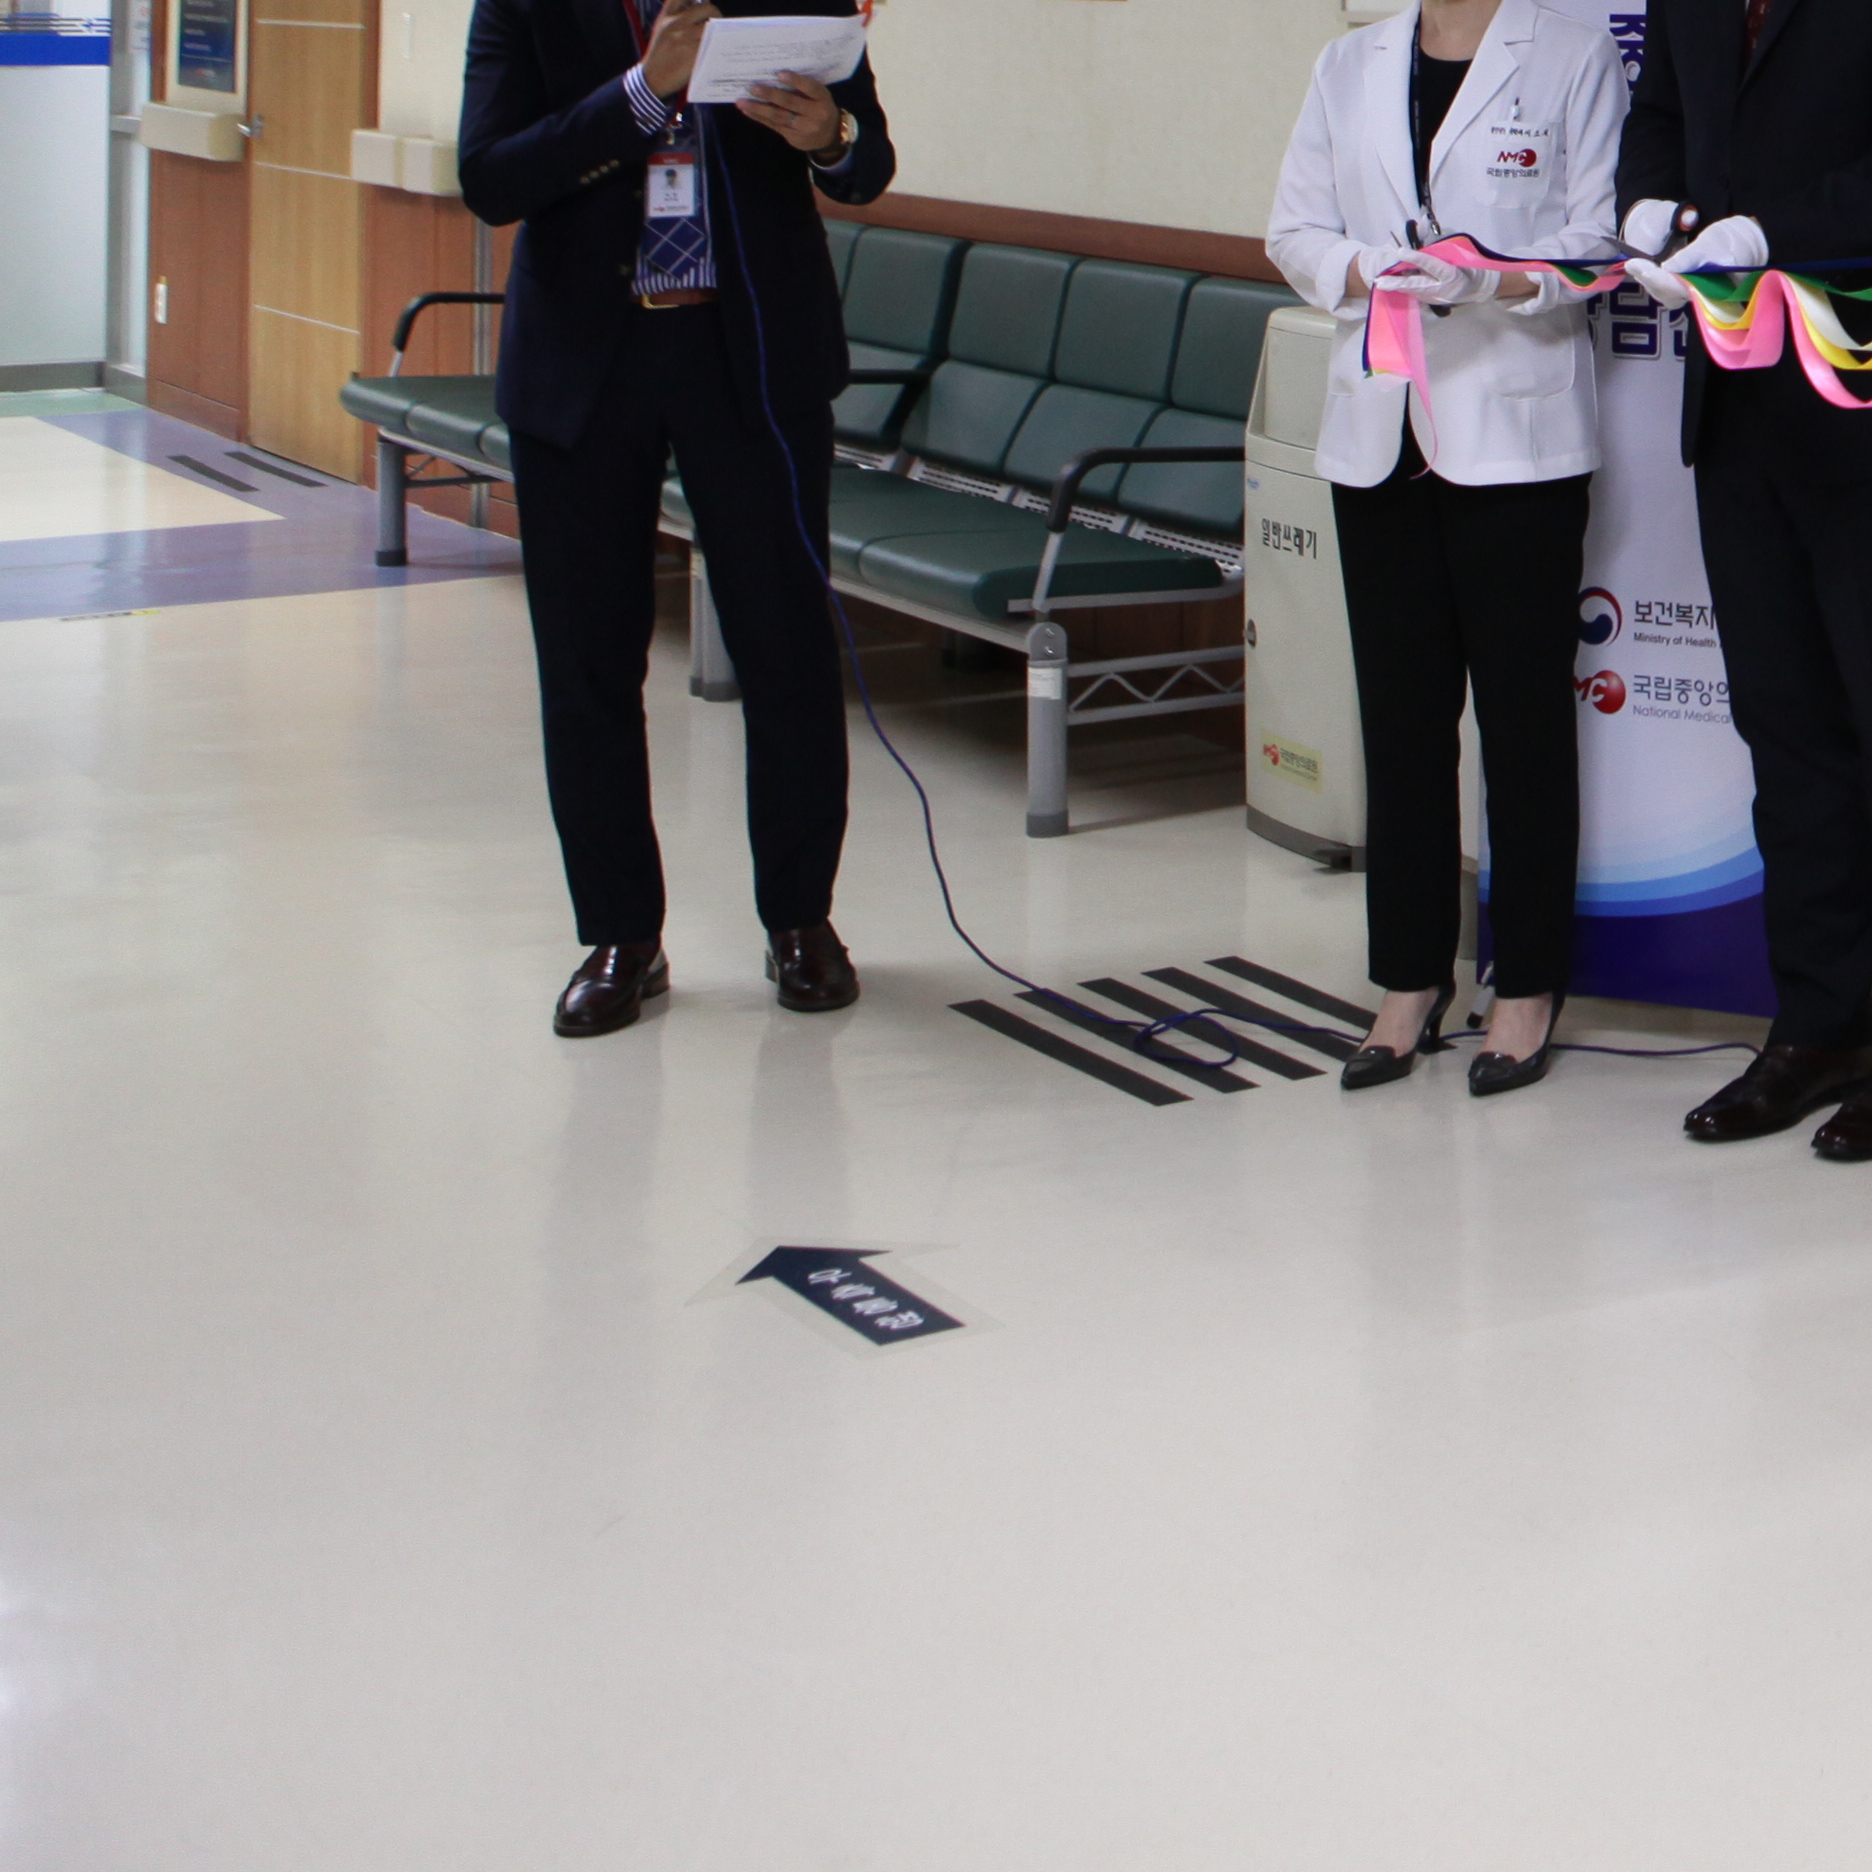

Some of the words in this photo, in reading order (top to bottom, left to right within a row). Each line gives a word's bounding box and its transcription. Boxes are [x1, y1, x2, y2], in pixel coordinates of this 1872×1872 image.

[1633, 632, 1671, 647] Ministry
[1673, 636, 1683, 646] of
[1685, 637, 1717, 649] Health
[1633, 705, 1681, 720] National
[1683, 710, 1733, 724] Medical
